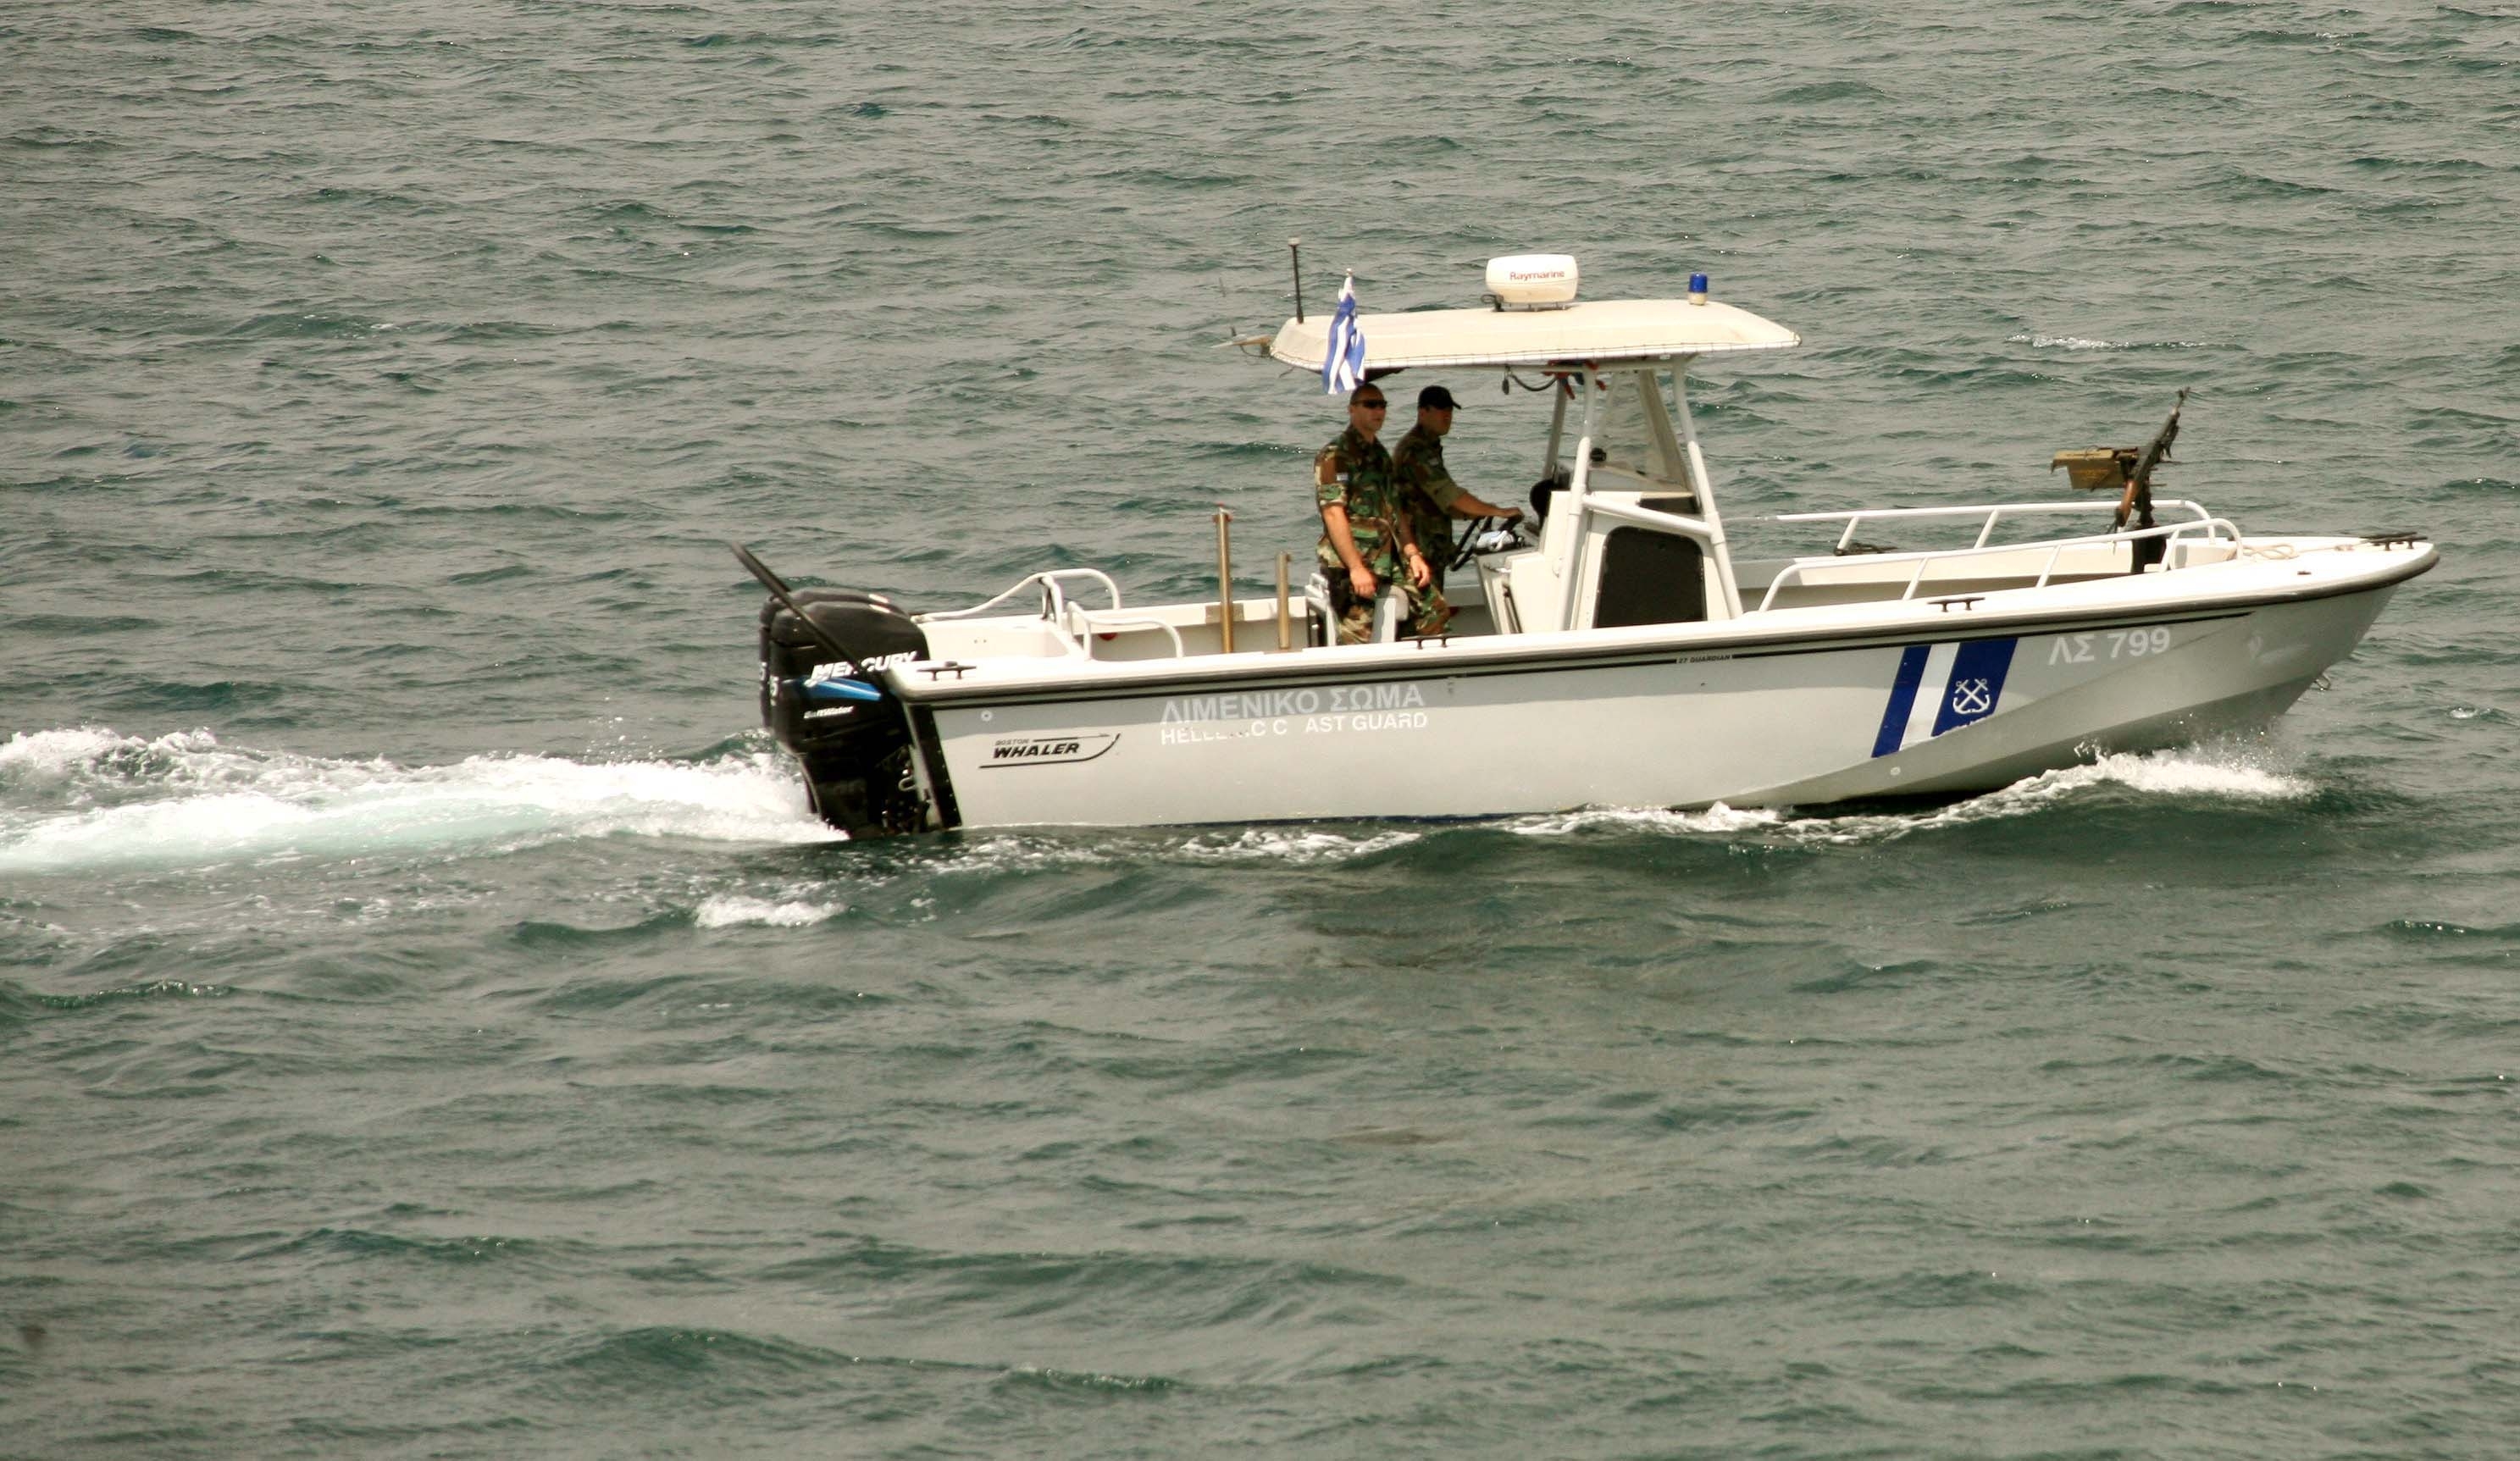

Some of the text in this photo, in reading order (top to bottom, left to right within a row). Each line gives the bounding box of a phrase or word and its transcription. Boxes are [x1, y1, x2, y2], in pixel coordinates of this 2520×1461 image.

[1509, 270, 1565, 281] Raymarine
[2047, 627, 2171, 667] ΛΣ 799
[1159, 683, 1426, 726] ΛΙΜΕΝΙΚΟ ΣΩΜΑ
[1351, 711, 1428, 732] GUARD
[992, 742, 1081, 760] WHALER
